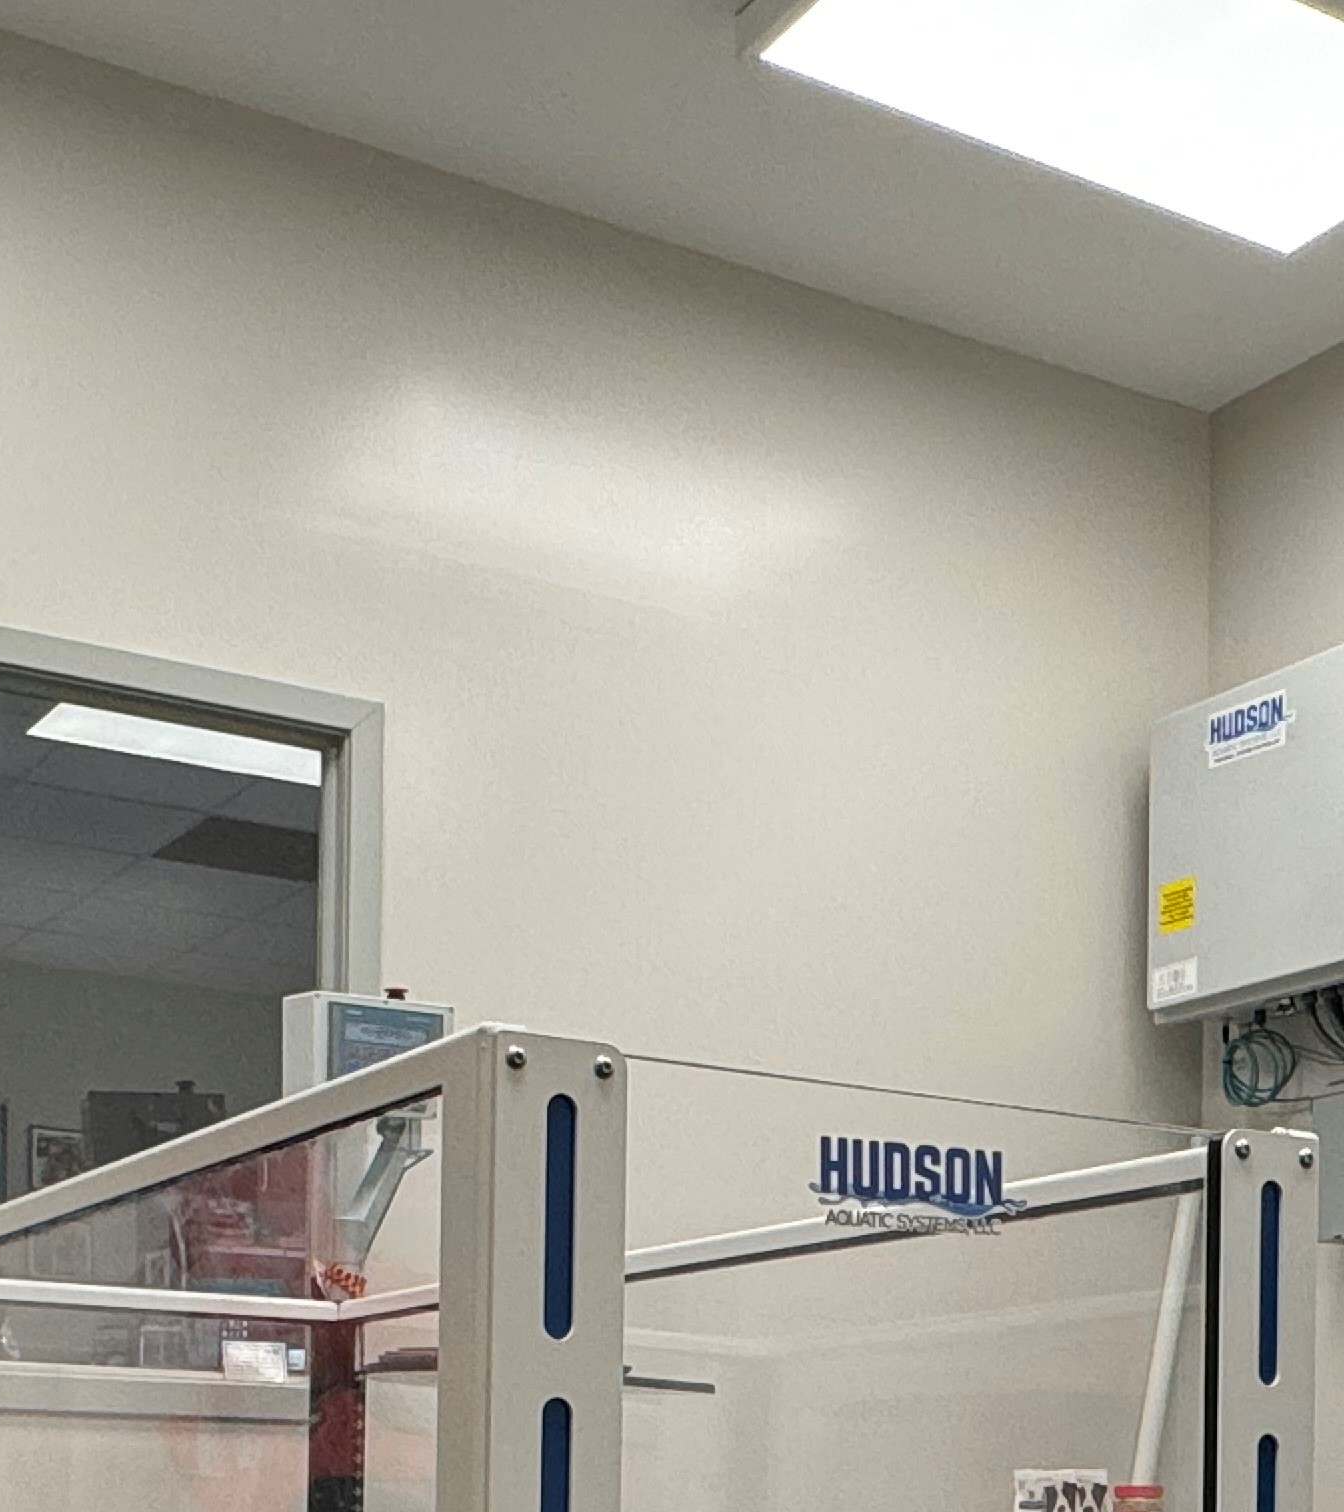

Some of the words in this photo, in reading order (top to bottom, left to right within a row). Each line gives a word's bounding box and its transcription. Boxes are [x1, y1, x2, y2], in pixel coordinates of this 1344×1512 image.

[1210, 695, 1284, 745] HUDSON
[820, 1136, 1003, 1206] HUDSON
[824, 1208, 893, 1229] AQUATIC
